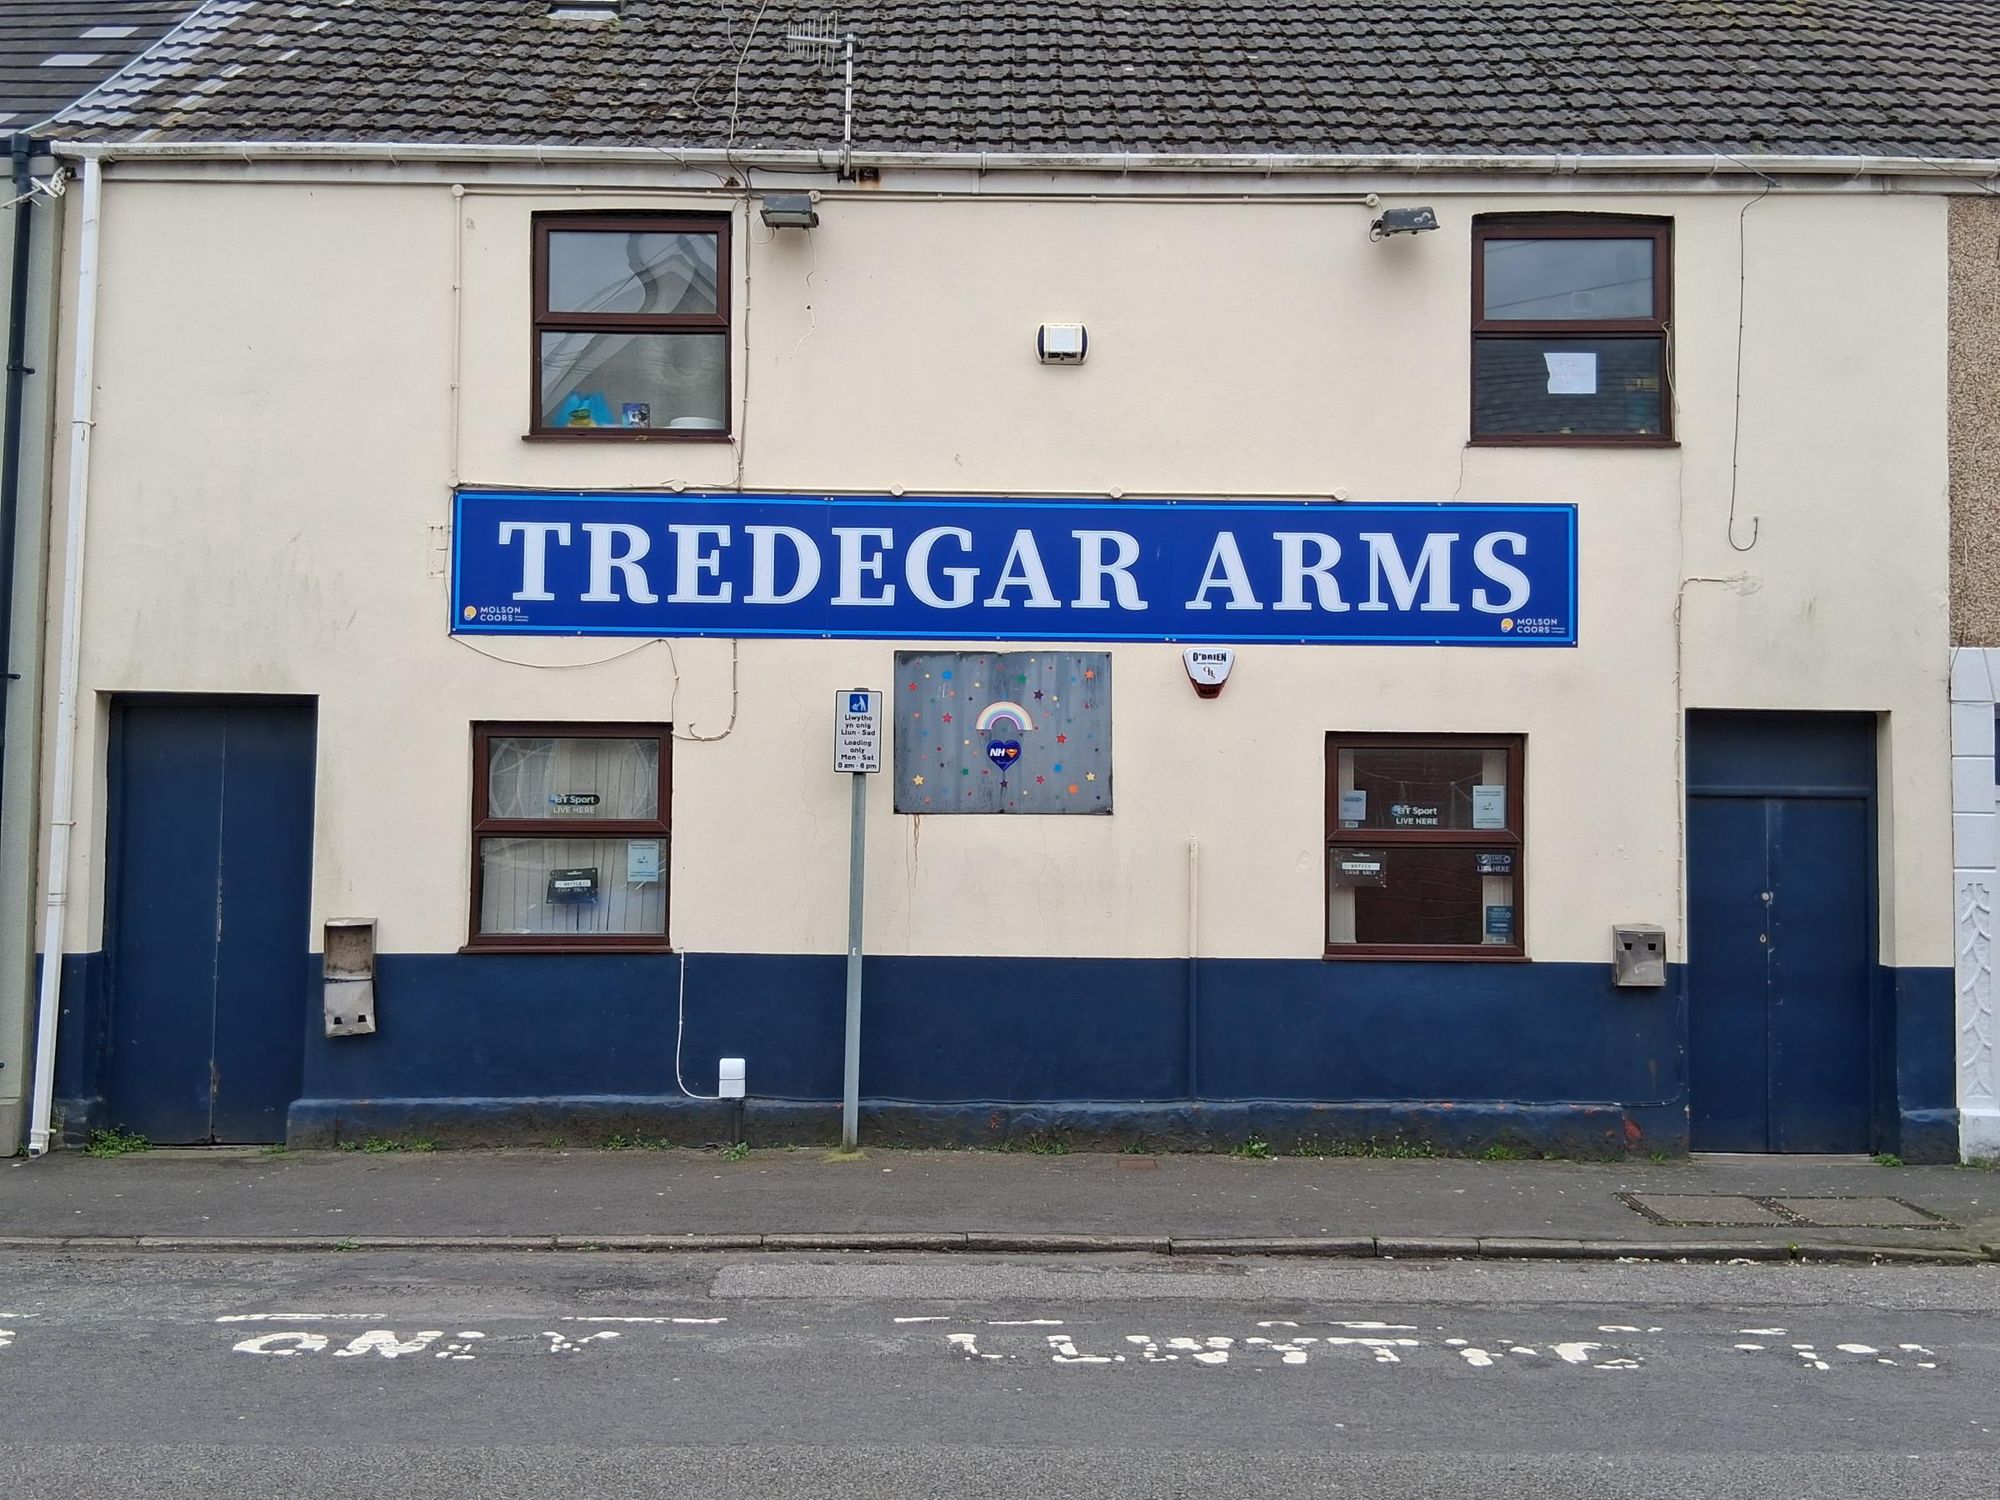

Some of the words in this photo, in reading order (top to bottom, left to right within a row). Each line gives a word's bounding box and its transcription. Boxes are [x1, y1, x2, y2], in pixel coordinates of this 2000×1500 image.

[499, 521, 1148, 611] TREDEGAR
[1186, 530, 1531, 614] ARMS
[480, 606, 521, 614] MOLSON
[480, 614, 513, 622] COORS
[1516, 618, 1558, 626] MOLSON
[1516, 626, 1550, 634] COORS
[569, 795, 595, 805] Sport
[553, 806, 571, 814] LIVE
[573, 806, 595, 814] HERE
[1412, 806, 1438, 816] Sport
[1395, 817, 1414, 825] LIVE
[1415, 817, 1438, 825] HERE
